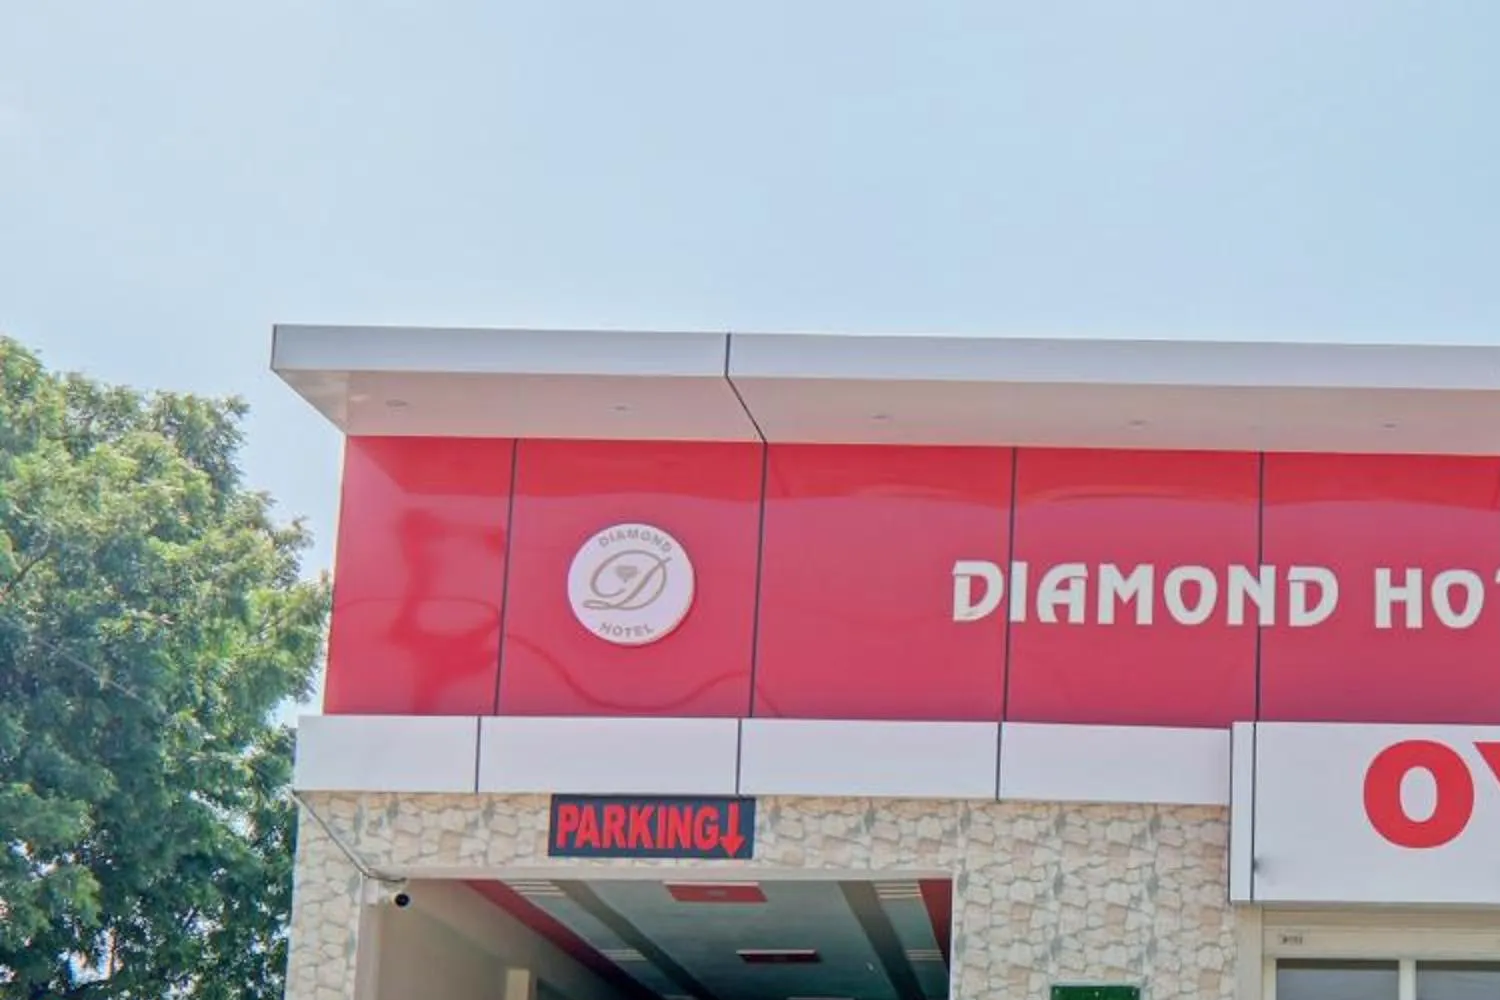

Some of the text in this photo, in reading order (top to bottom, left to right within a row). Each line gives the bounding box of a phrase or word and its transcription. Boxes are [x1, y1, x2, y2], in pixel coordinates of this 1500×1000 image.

[598, 529, 673, 554] DIAMOND
[952, 560, 1339, 627] DIAMOND
[599, 621, 655, 638] HOTEL
[556, 802, 720, 851] PARKING
